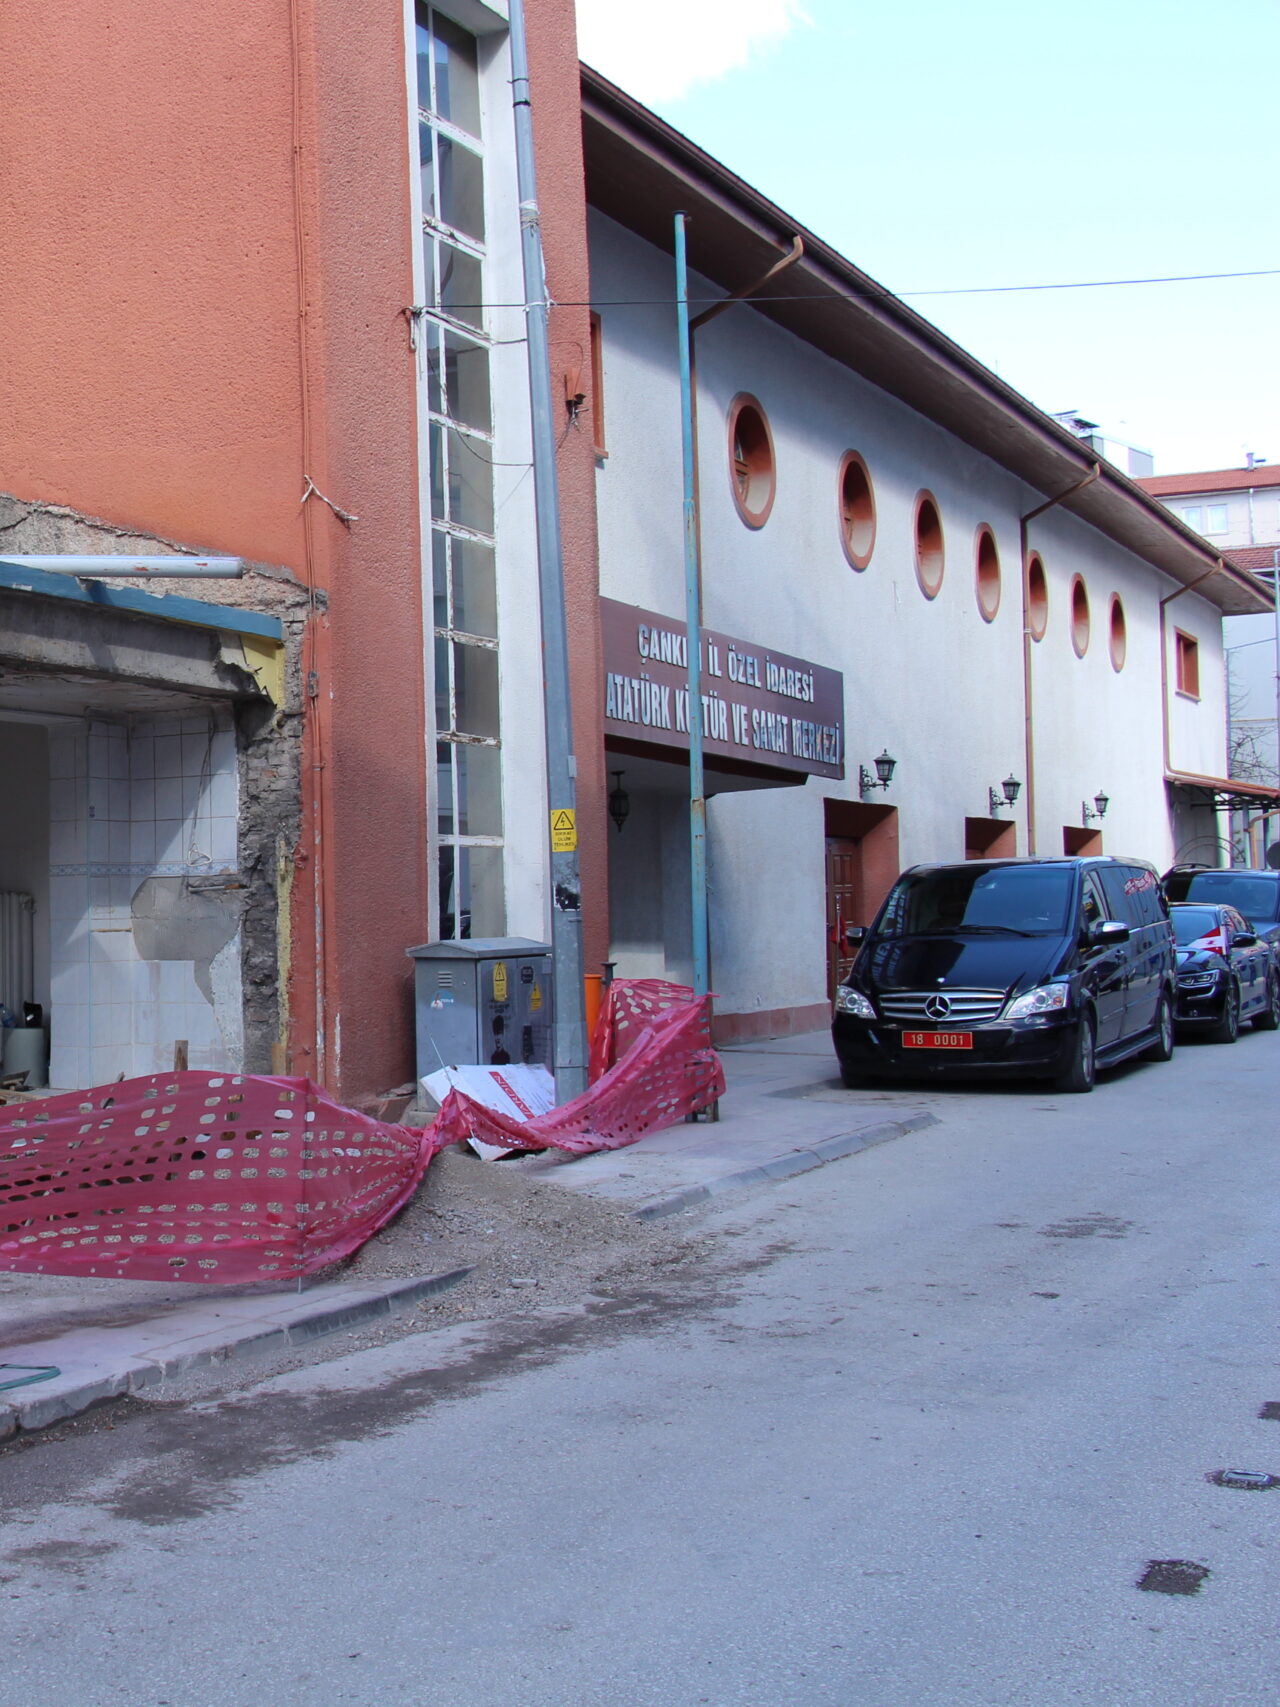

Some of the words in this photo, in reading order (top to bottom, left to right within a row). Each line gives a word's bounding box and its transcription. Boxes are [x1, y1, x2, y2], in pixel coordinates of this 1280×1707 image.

[638, 624, 702, 672] ÇANKII
[709, 638, 722, 678] İL
[728, 644, 762, 688] ÖZEL
[766, 655, 814, 703] İDARESİ
[606, 672, 671, 730] ATATÜRK
[731, 703, 749, 745] VE
[752, 709, 788, 754] SANAT
[791, 719, 840, 765] MERKEZİ
[911, 1034, 924, 1045] 18
[934, 1035, 964, 1046] 0001
